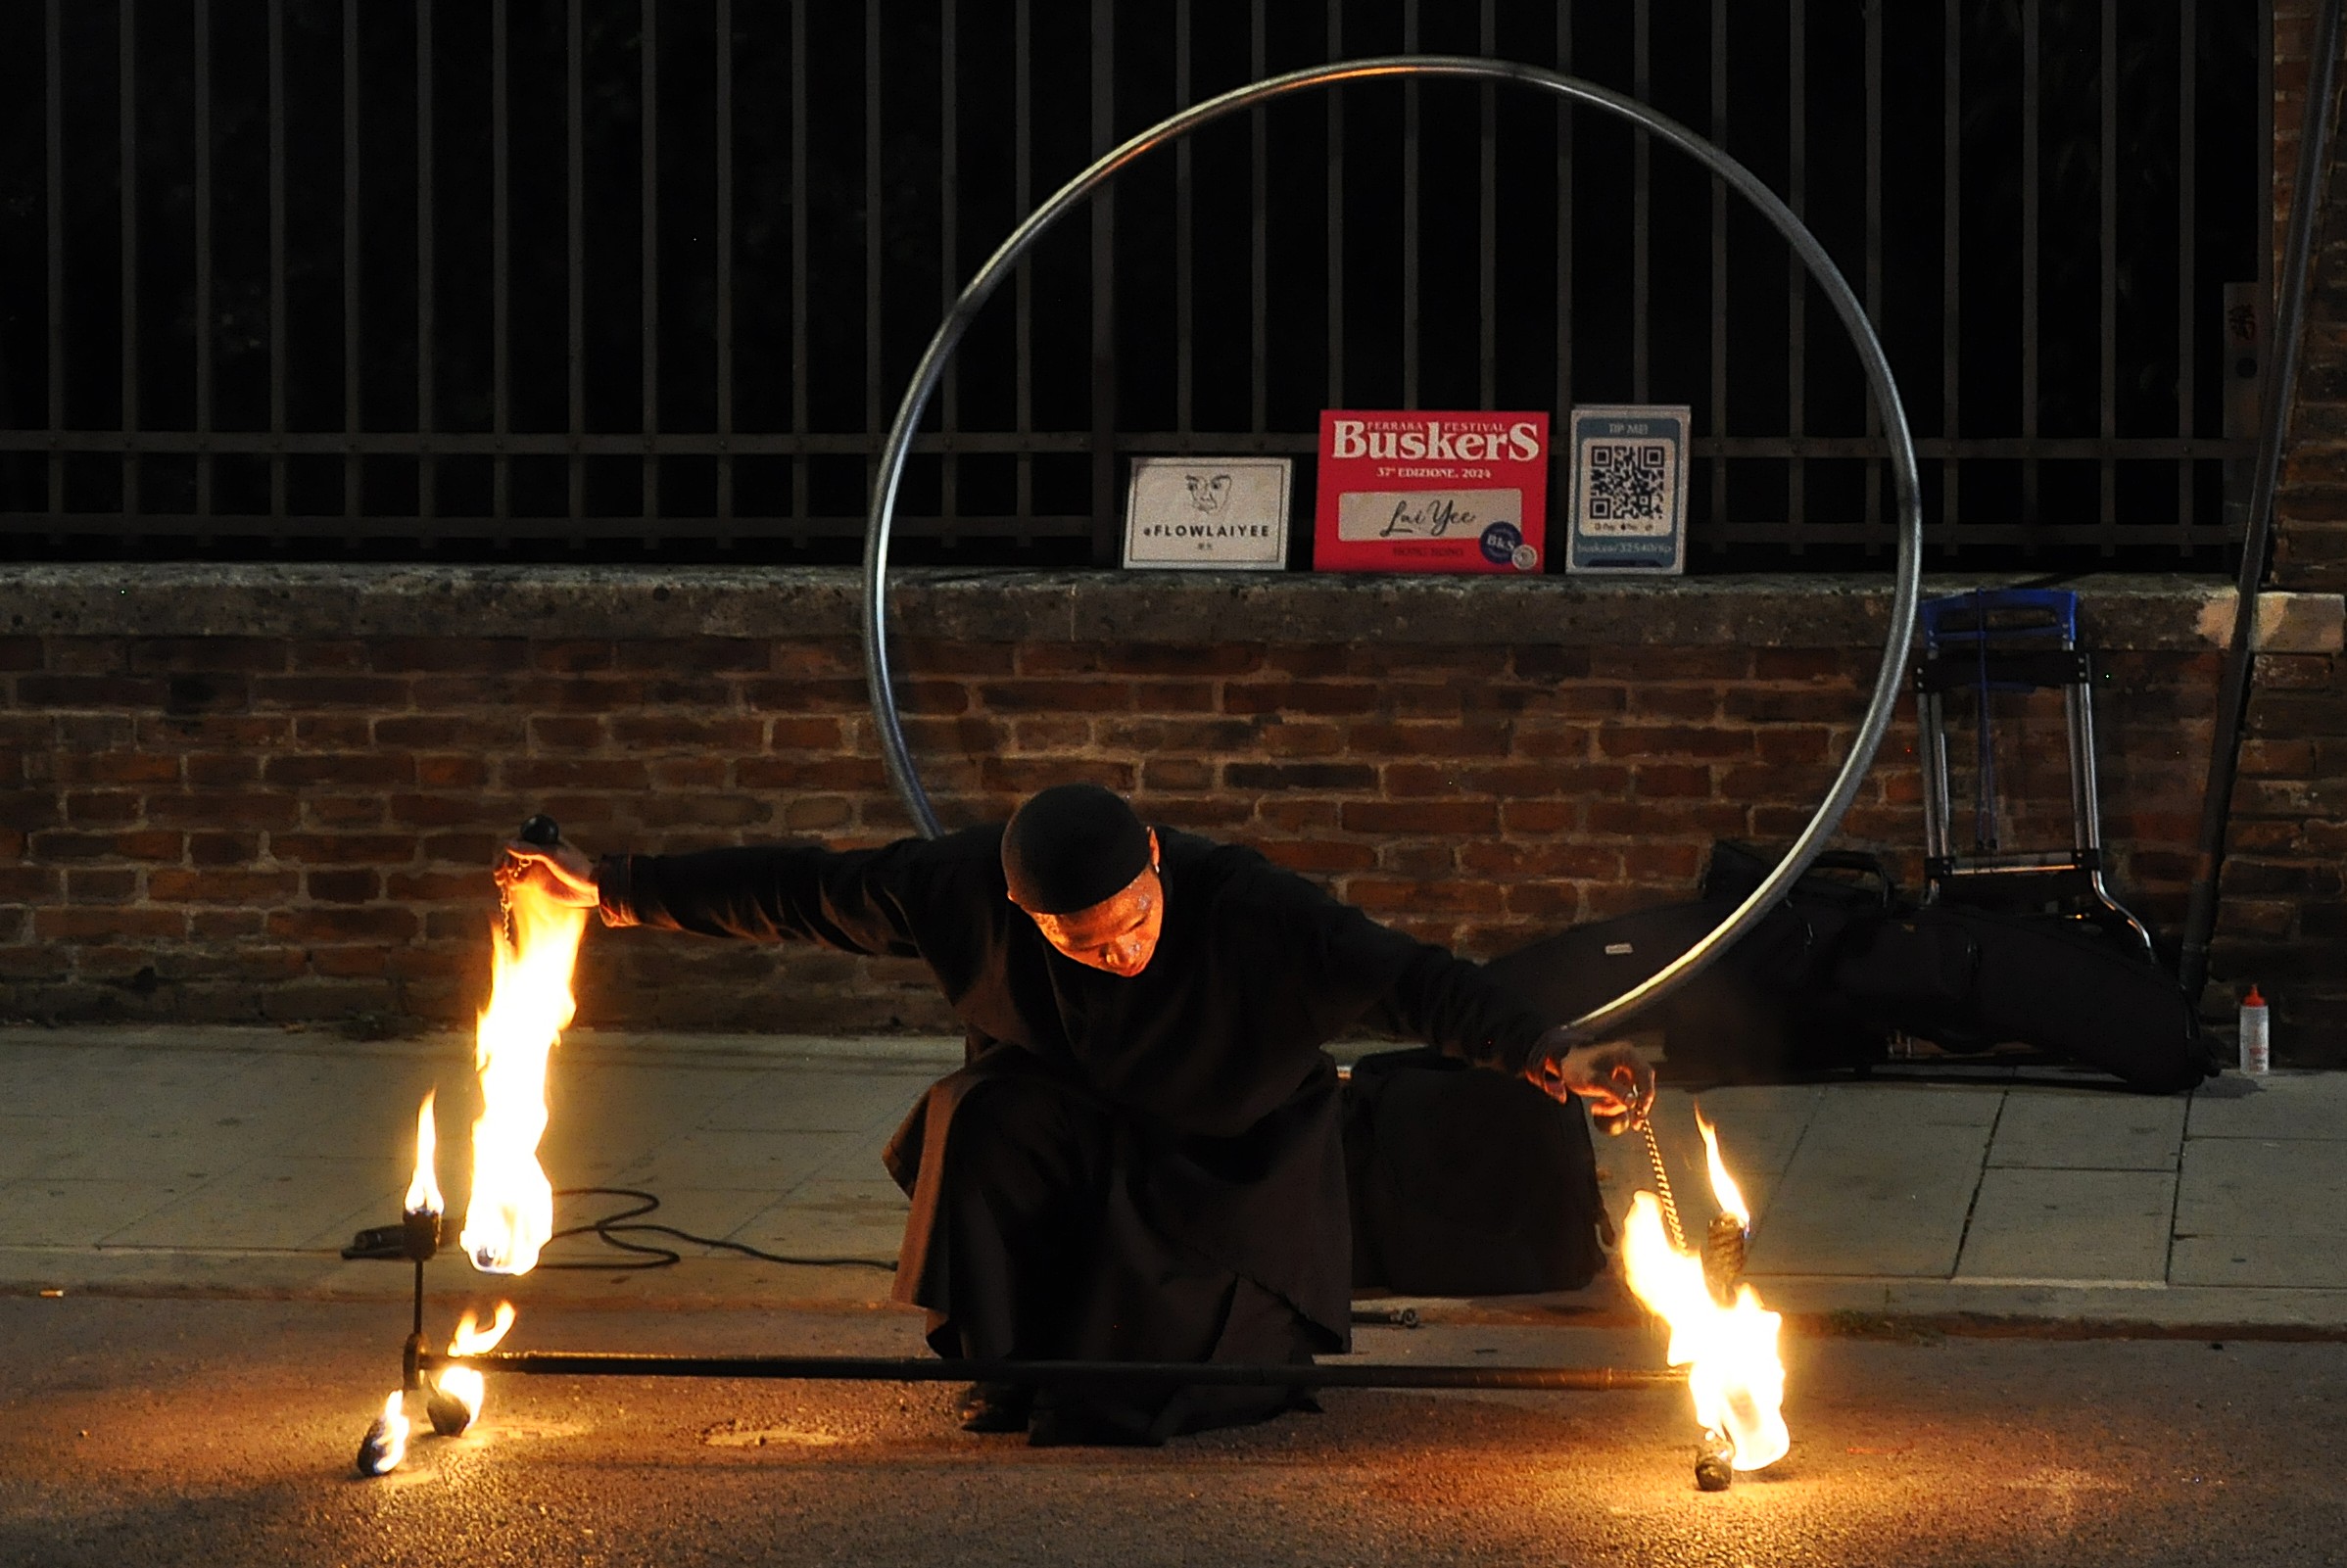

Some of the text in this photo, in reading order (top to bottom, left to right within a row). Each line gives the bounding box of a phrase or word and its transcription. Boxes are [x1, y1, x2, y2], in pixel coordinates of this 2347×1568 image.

[1366, 421, 1506, 432] FERRARA FESTIVAL
[1608, 423, 1625, 434] TIP
[1331, 419, 1539, 462] BuskerS
[1461, 468, 1492, 479] 2024
[1378, 499, 1477, 538] Lai Yee
